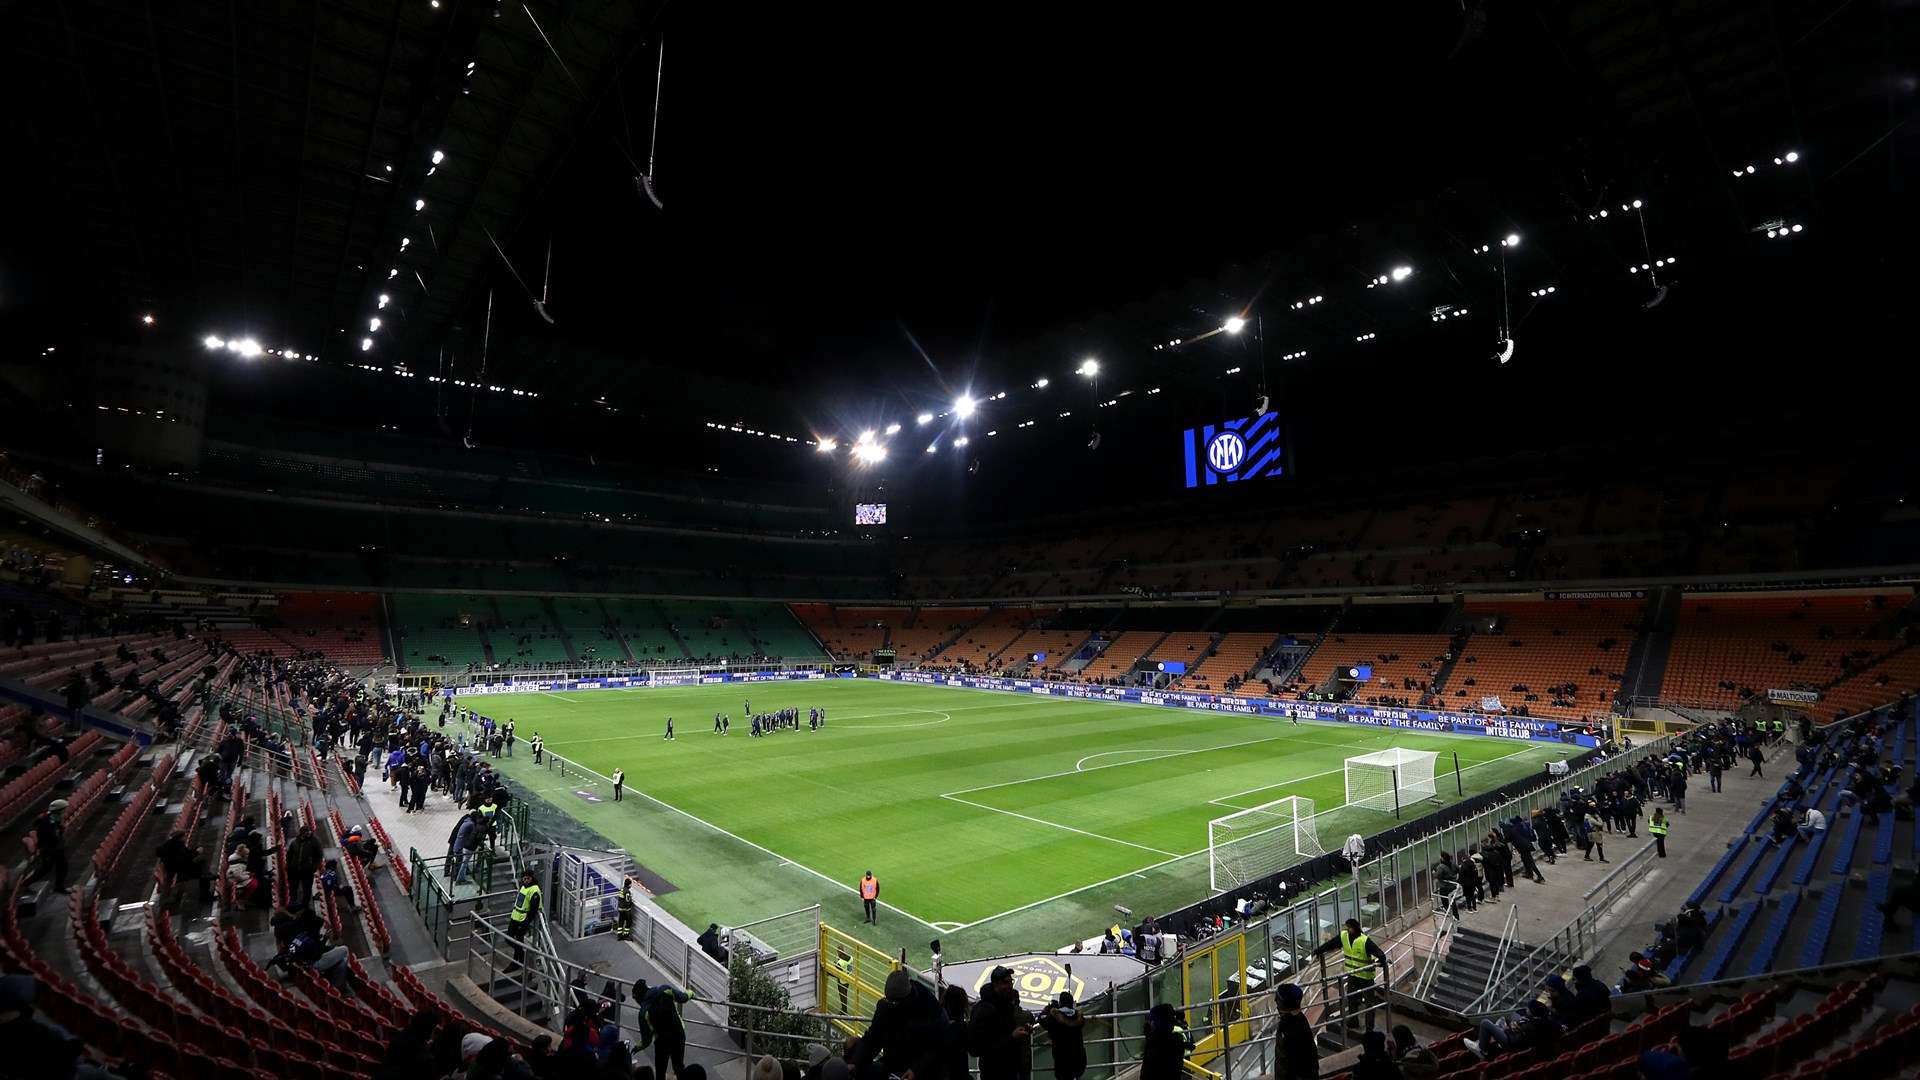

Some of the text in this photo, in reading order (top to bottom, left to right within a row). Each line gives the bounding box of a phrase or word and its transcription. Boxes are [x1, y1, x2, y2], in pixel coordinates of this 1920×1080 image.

[1278, 702, 1293, 710] PART
[1295, 703, 1304, 711] OF
[1306, 704, 1319, 712] THE
[1348, 715, 1445, 730] BE PART OF THE FAMILY
[1438, 715, 1449, 723] BE
[1451, 716, 1472, 726] PART
[1509, 721, 1545, 731] FAMILY
[1485, 726, 1531, 739] INTER CLUB
